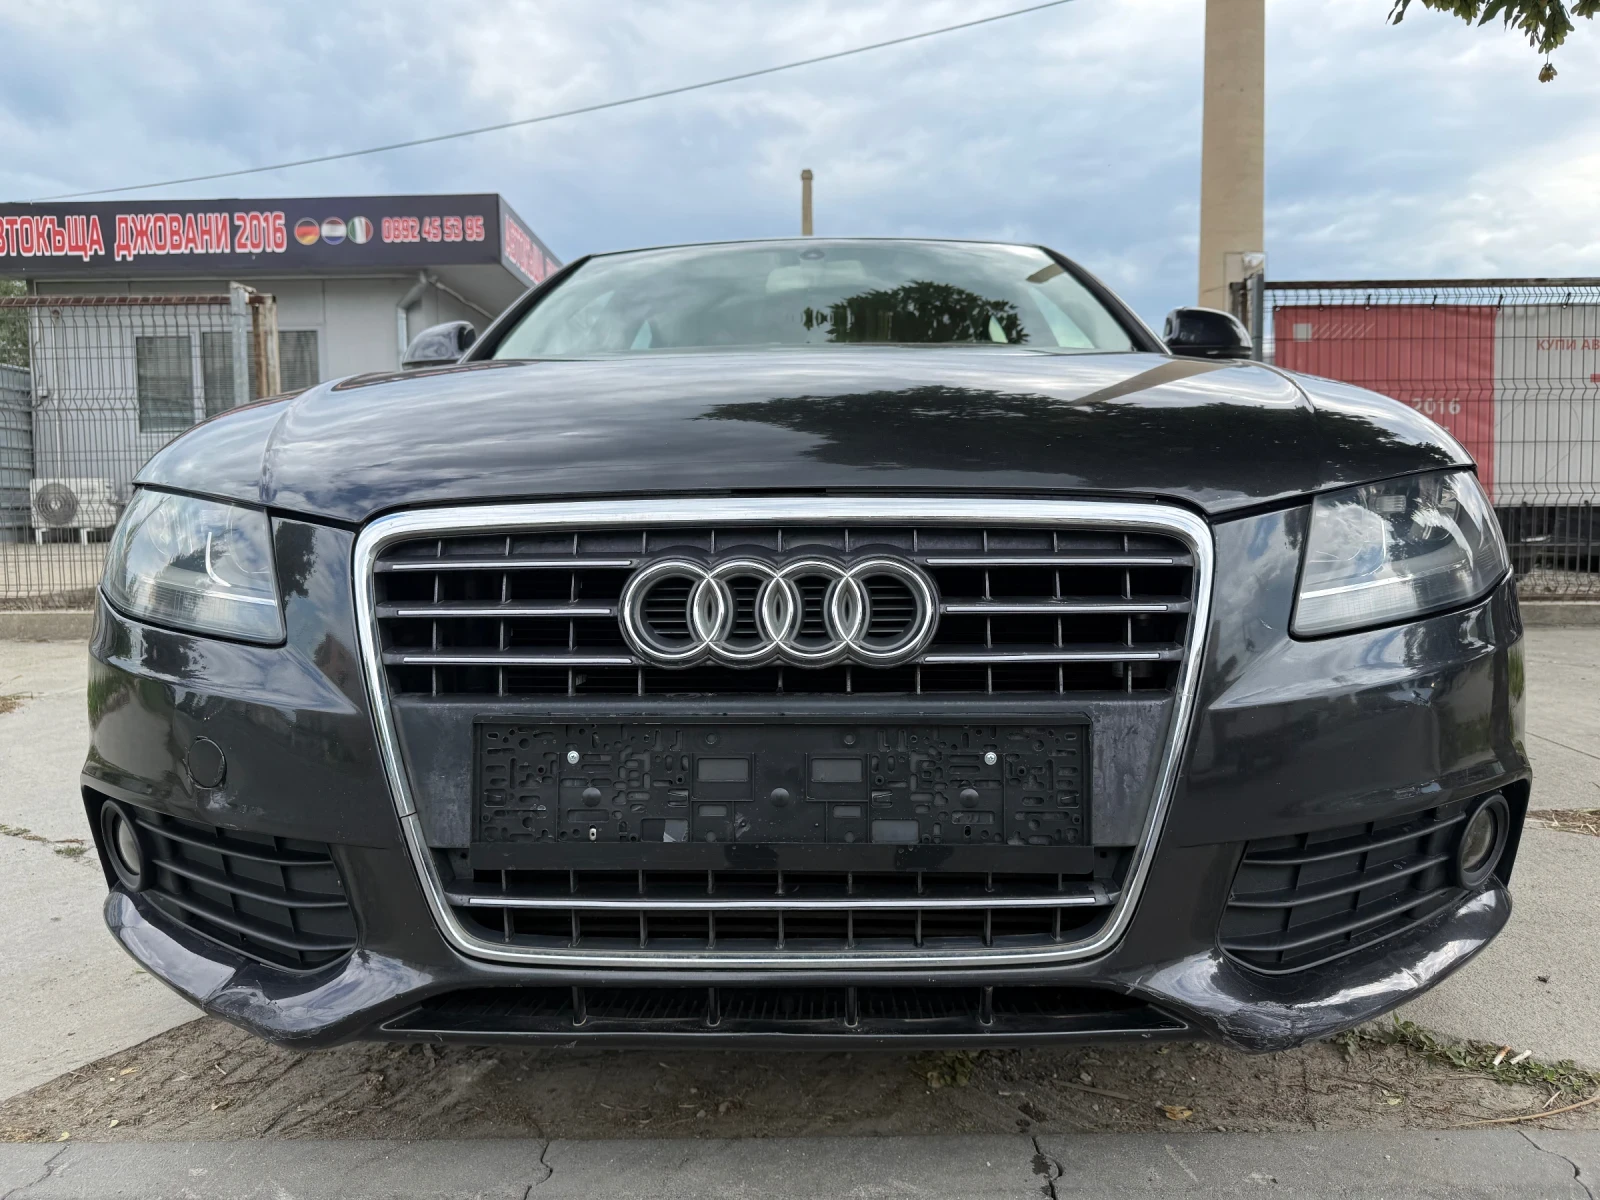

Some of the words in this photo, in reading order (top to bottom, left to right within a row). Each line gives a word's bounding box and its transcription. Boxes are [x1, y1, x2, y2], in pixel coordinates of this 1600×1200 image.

[114, 213, 231, 261] ДЖОВАНИ
[234, 211, 287, 252] 2016
[382, 216, 420, 243] 0892
[421, 216, 442, 242] 45
[443, 216, 463, 242] 53
[464, 215, 485, 241] 95
[1536, 339, 1577, 351] КУПИ
[1411, 398, 1461, 415] 2016
